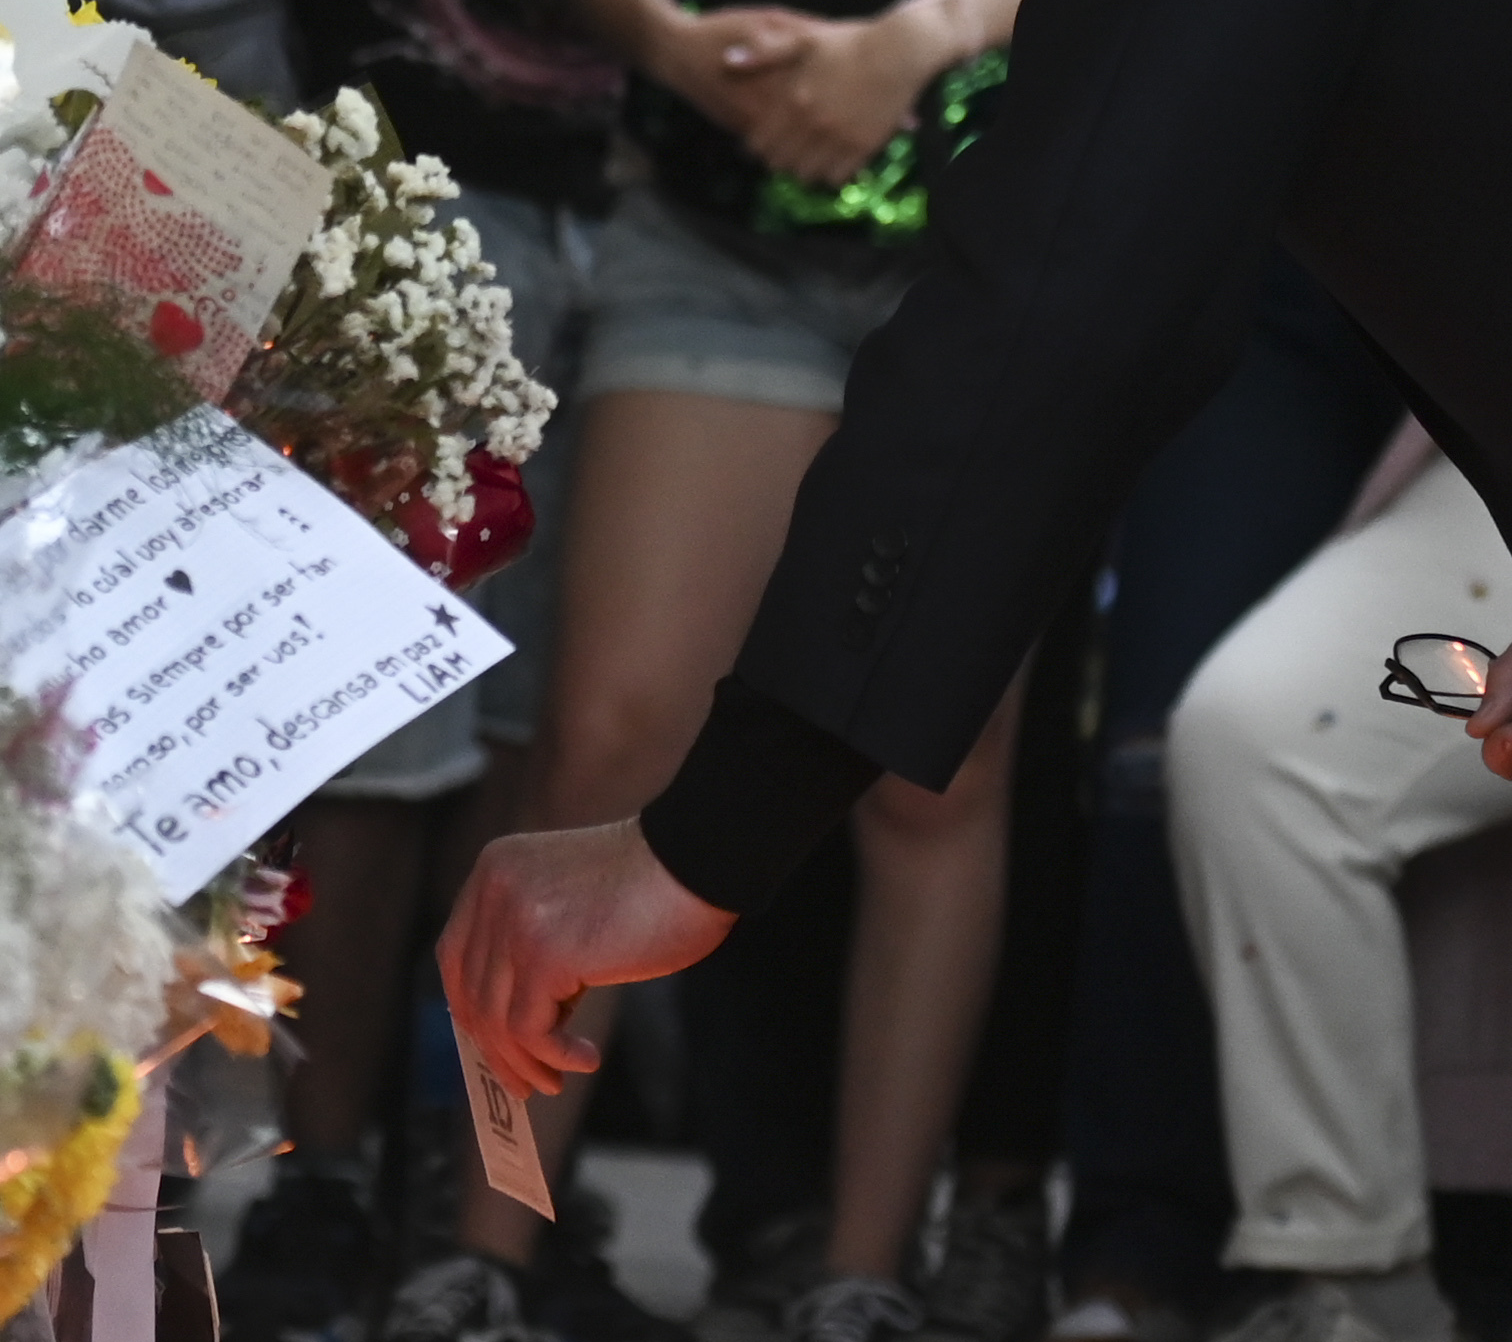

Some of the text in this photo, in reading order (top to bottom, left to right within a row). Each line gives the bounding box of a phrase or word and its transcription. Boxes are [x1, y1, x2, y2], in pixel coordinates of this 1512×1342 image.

[67, 488, 146, 544] darme
[62, 586, 95, 608] lo
[106, 594, 169, 647] amor
[125, 632, 225, 706] siempre
[222, 601, 260, 639] por
[261, 576, 297, 608] ser
[184, 696, 222, 738] por
[226, 663, 263, 698] ser
[397, 650, 474, 706] LIAM
[111, 633, 444, 859] Te amo, descansa en paz
